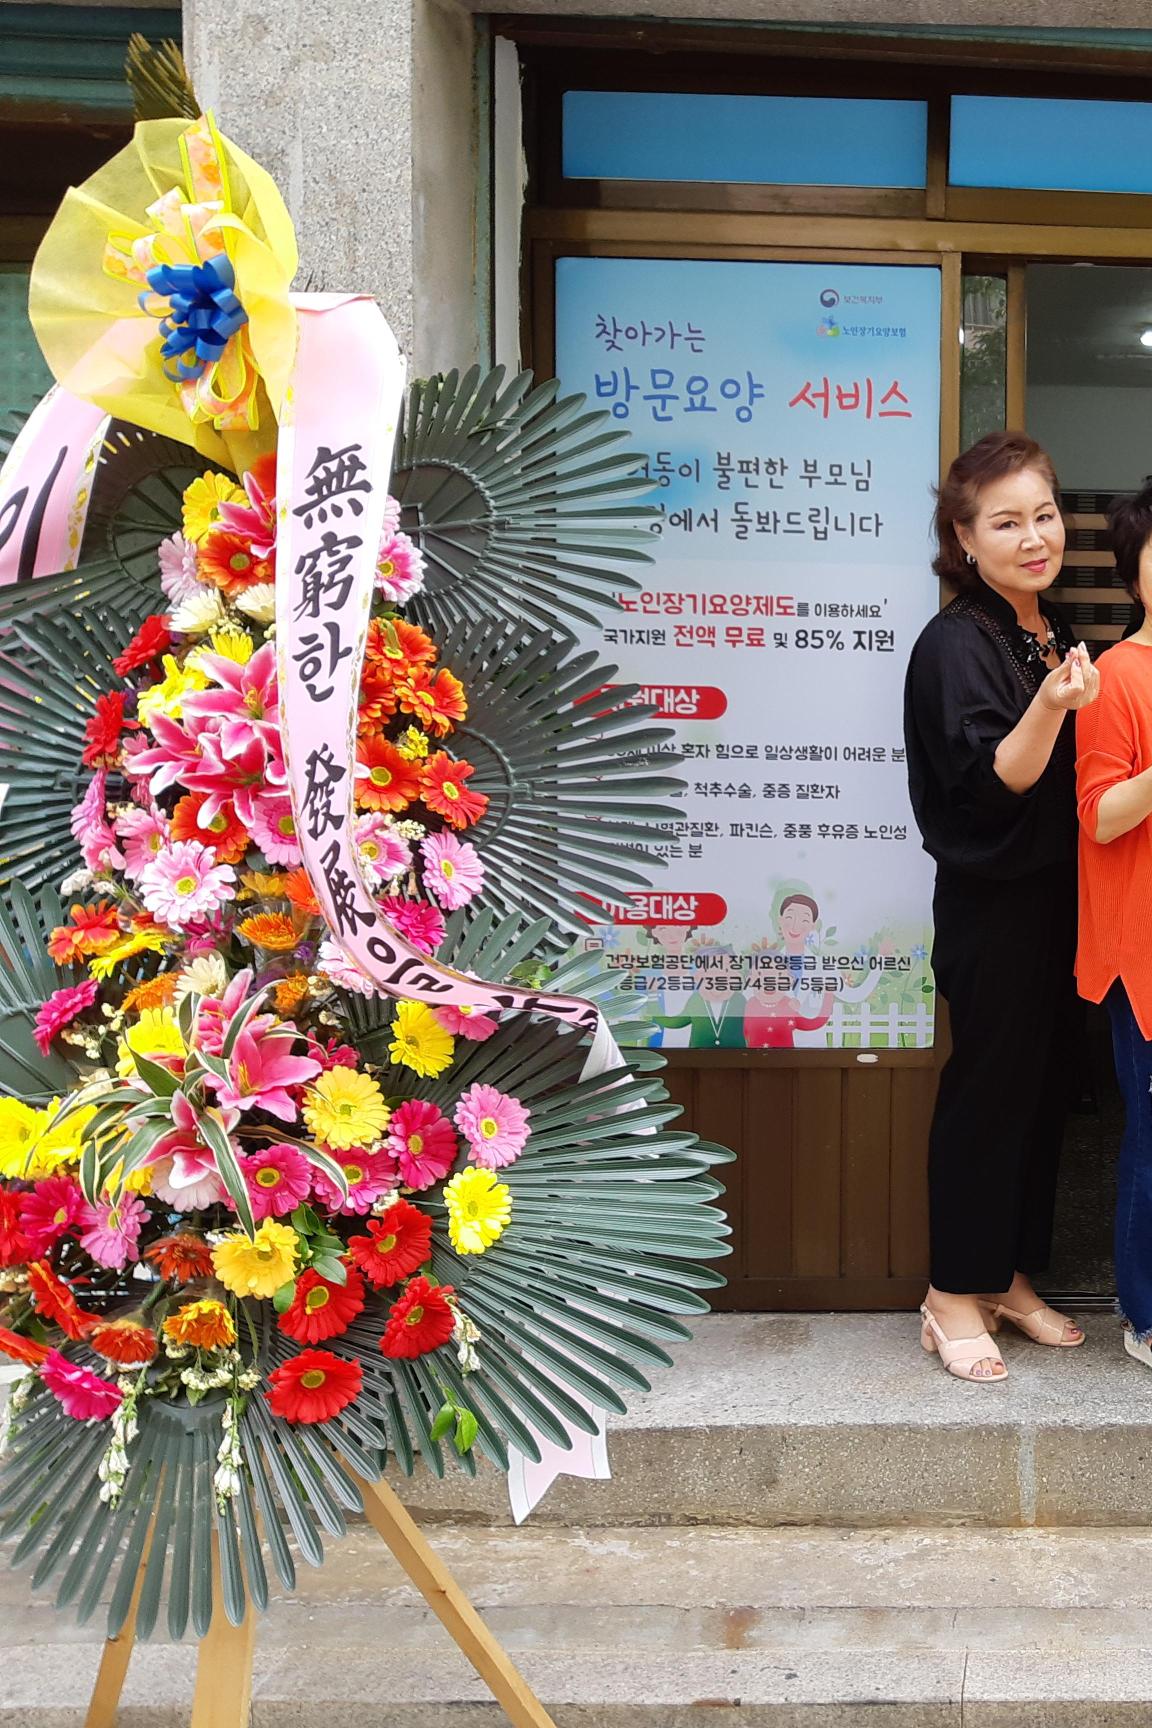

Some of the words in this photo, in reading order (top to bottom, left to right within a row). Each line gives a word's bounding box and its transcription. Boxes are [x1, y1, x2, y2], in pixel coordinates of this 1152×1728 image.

[595, 314, 706, 353] 찾아가는
[594, 366, 765, 423] 방문요양
[788, 376, 913, 420] 서비스
[712, 451, 788, 490] 불편한
[798, 458, 873, 493] 부모님
[645, 502, 719, 534] 에서
[730, 501, 883, 542] 돌봐드립니다
[603, 628, 667, 646] 국가지원
[673, 624, 716, 648] 전액
[724, 625, 767, 648] 무료
[773, 631, 788, 649] 및
[794, 628, 845, 651] 85%
[852, 628, 895, 652] 지원
[681, 742, 710, 760] 혼자
[715, 743, 759, 760] 힘으로
[764, 744, 838, 762] 일상생활이
[843, 746, 886, 762] 어려운
[890, 747, 906, 763] 분
[694, 781, 757, 799] 척추수술,
[762, 782, 791, 799] 중증
[795, 782, 841, 800] 질환자
[728, 822, 778, 839] 파킨슨,
[783, 822, 813, 839] 중풍
[817, 823, 860, 840] 후유증
[863, 824, 908, 841] 노인성
[688, 842, 703, 859] 분
[605, 953, 724, 971] 건강보험공단에서
[728, 953, 818, 972] 장기요양등급
[822, 955, 865, 971] 받으신
[869, 955, 912, 972] 어르신
[615, 975, 845, 993] 등급/2등급/3등급/4등급/5등급)
